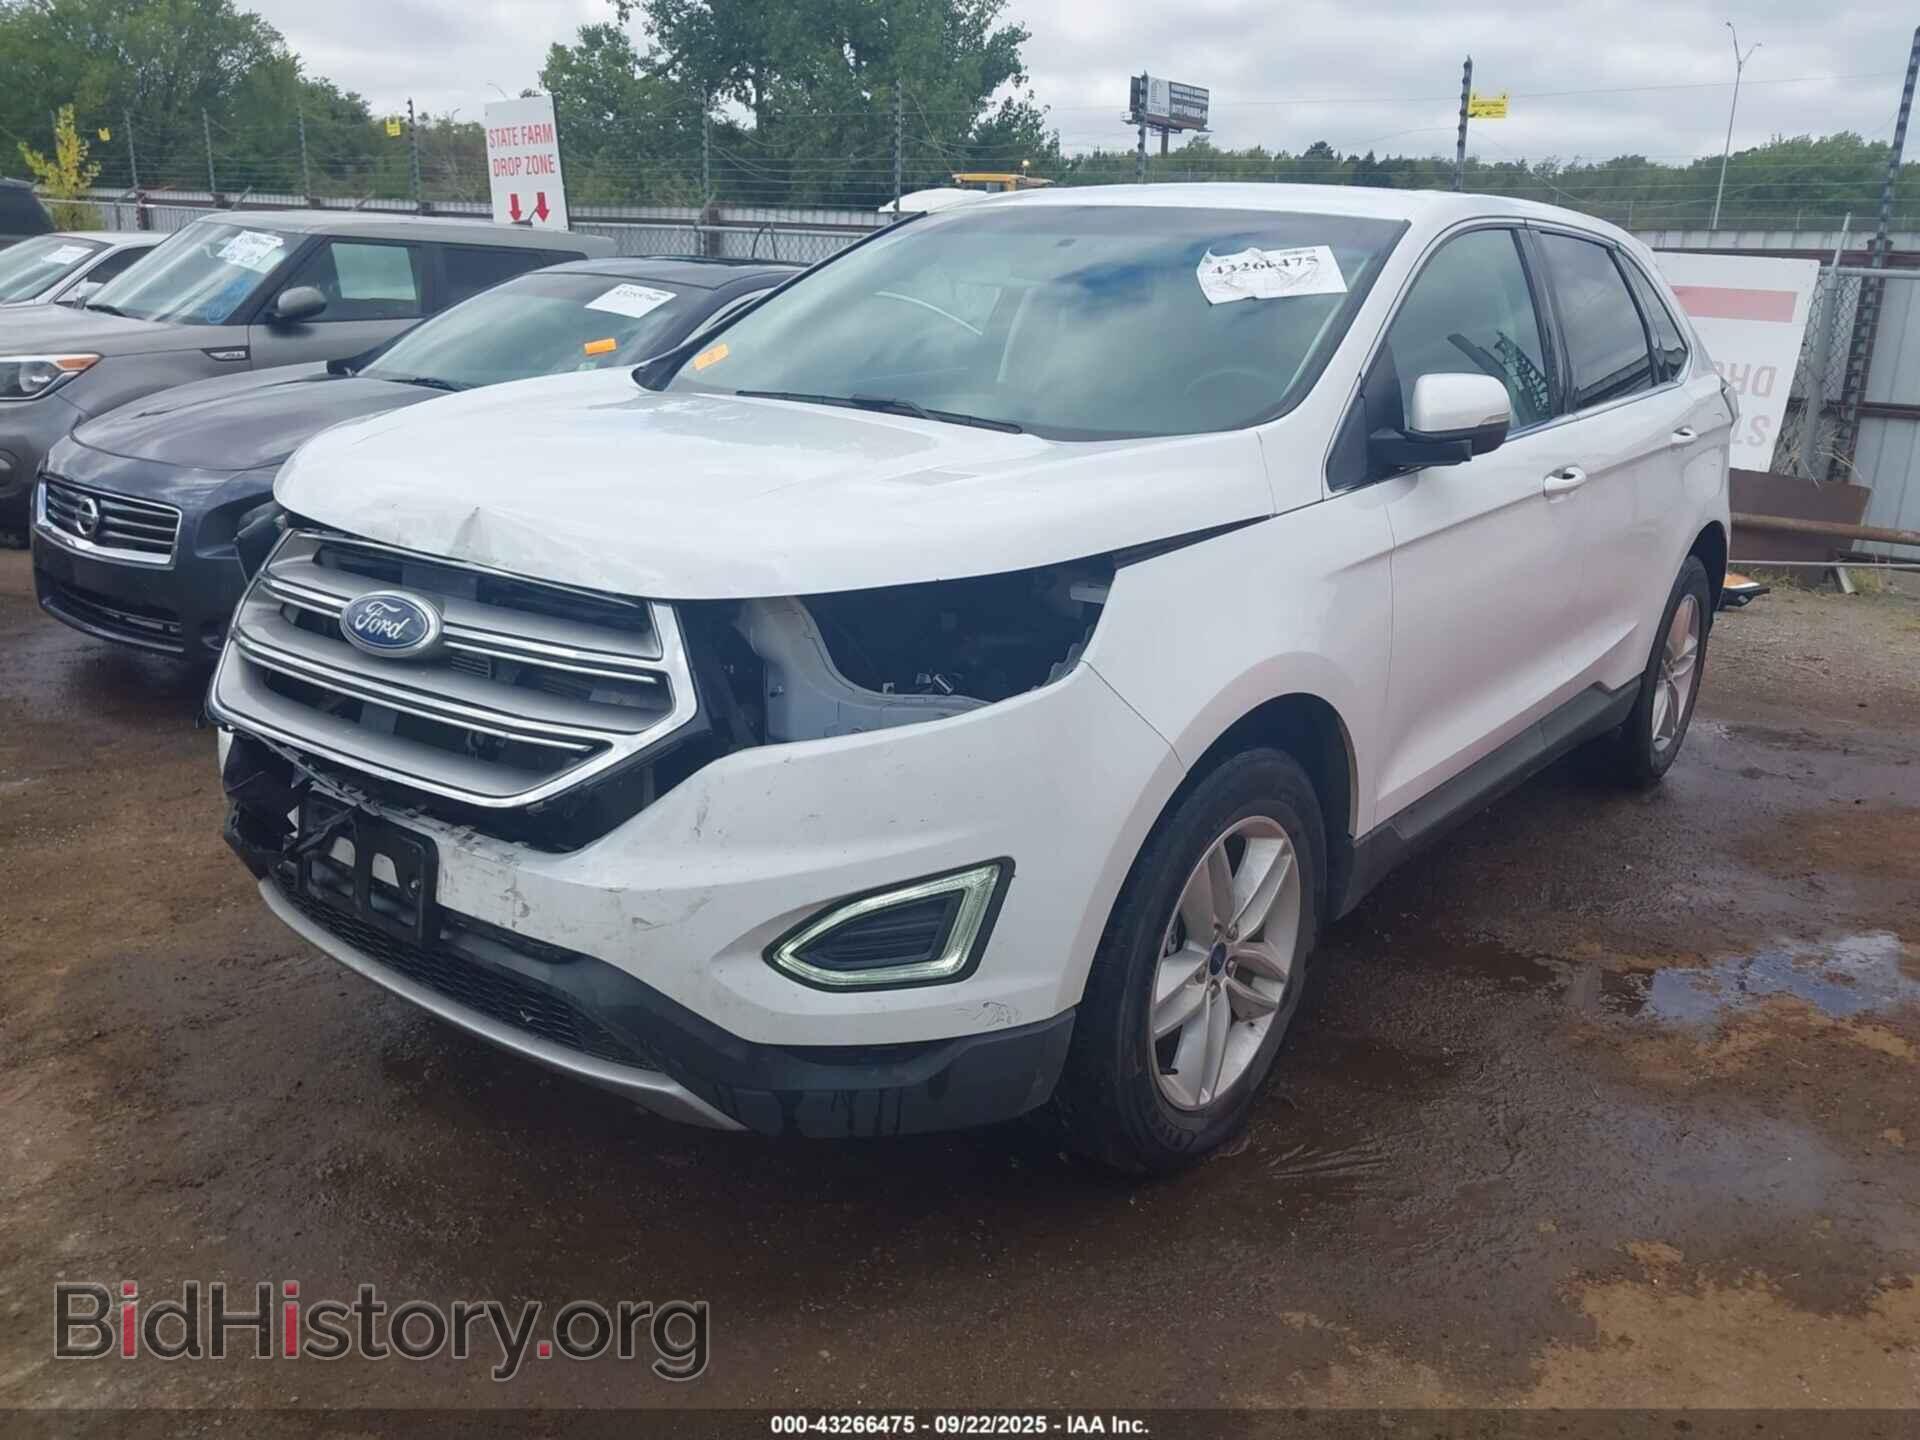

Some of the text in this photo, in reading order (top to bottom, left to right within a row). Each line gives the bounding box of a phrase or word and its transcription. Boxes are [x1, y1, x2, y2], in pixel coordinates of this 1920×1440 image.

[489, 123, 553, 148] STATE FARM
[493, 154, 556, 177] DROP ZONE
[355, 602, 411, 640] Ford
